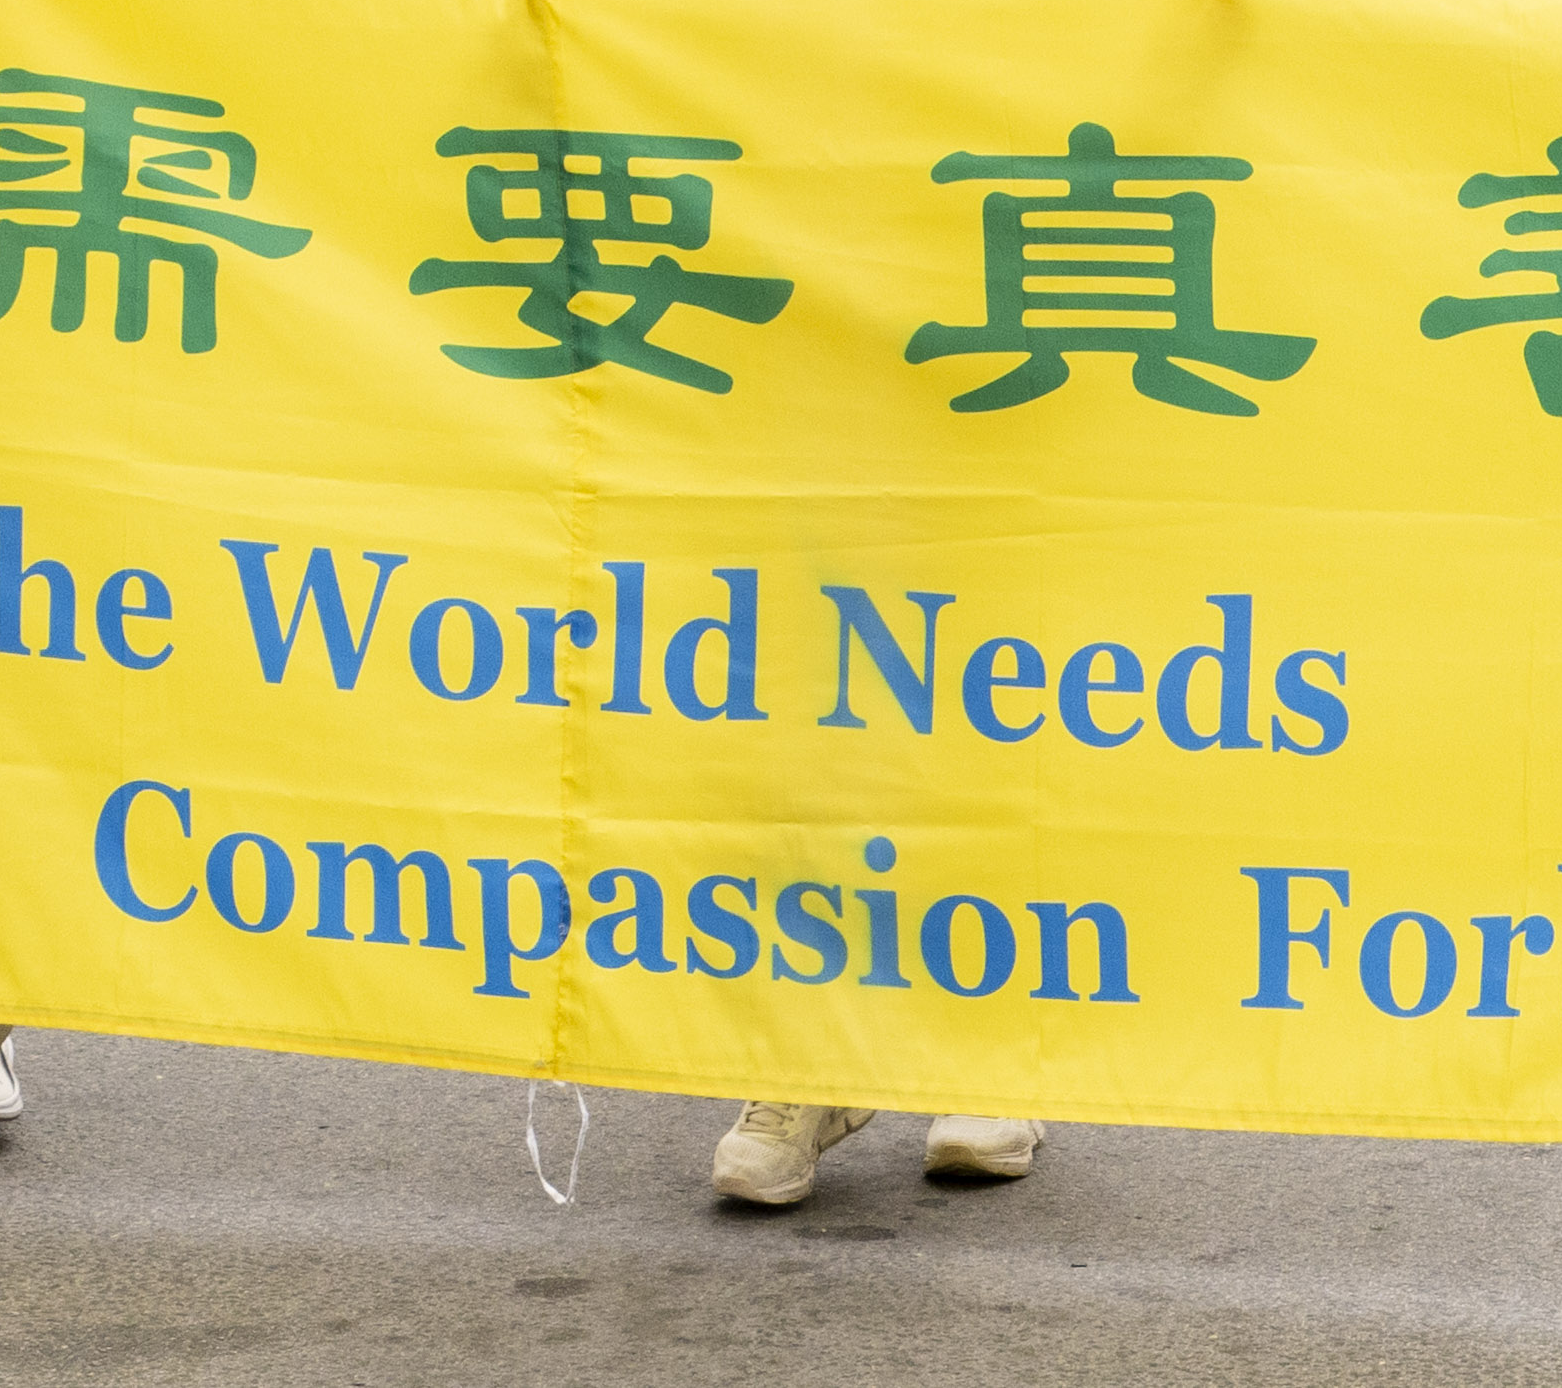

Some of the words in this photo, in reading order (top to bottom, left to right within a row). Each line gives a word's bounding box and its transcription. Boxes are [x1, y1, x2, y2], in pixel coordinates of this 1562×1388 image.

[219, 538, 769, 722] World
[815, 583, 1351, 757] Needs
[93, 779, 1142, 1003] Compassion
